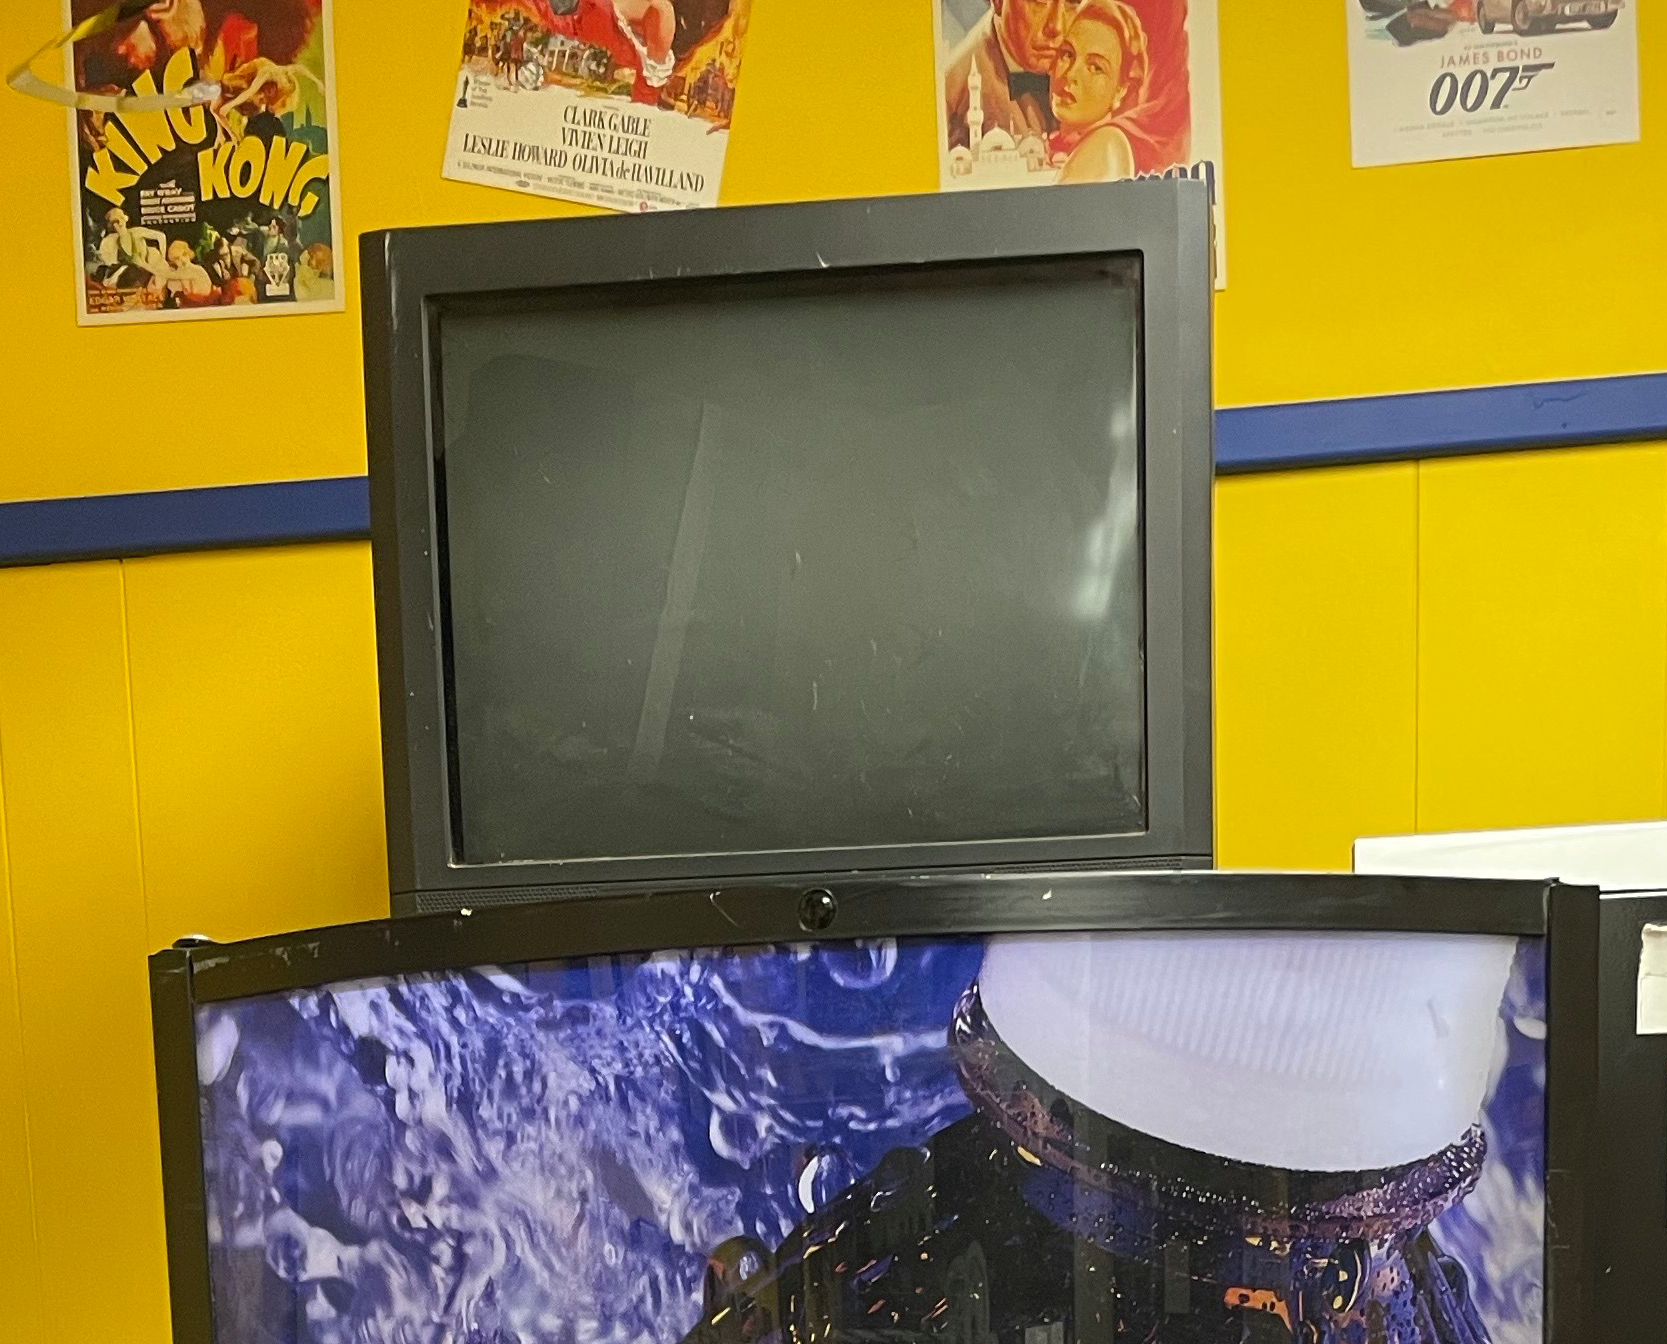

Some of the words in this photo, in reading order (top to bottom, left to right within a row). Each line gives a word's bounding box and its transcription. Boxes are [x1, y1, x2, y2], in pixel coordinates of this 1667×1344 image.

[1440, 51, 1490, 69] JAMES
[1497, 47, 1543, 62] BOND
[1429, 65, 1522, 116] 007
[85, 46, 207, 206] KING
[561, 127, 605, 151] VIVIEN
[608, 137, 649, 160] LEIGH
[563, 105, 605, 130] CLARK
[608, 113, 652, 137] GABLE
[198, 135, 329, 217] KONG
[463, 133, 508, 159] LESLIE
[511, 142, 567, 169] HOWARD
[572, 153, 616, 178] OLIVIA
